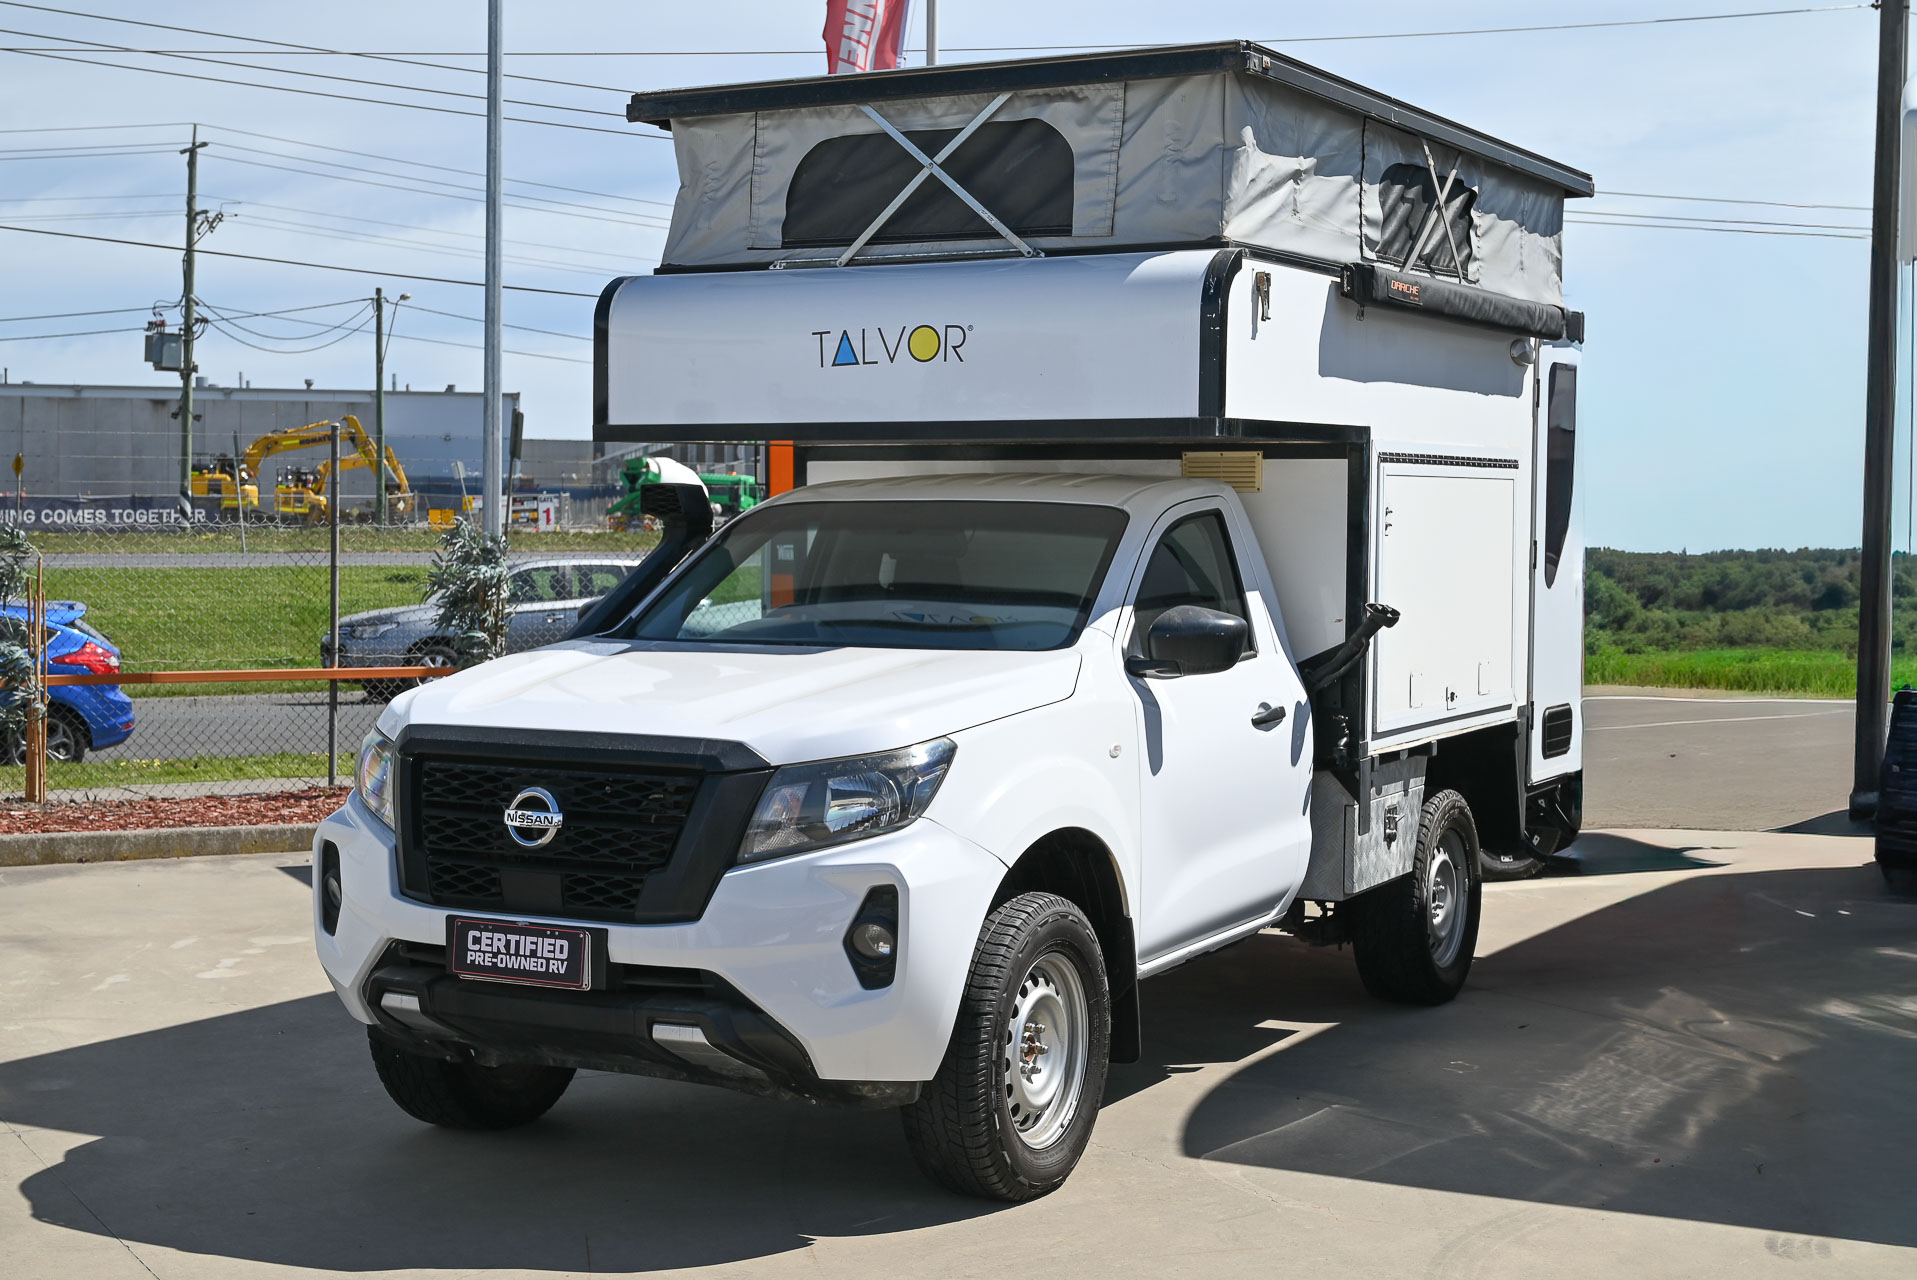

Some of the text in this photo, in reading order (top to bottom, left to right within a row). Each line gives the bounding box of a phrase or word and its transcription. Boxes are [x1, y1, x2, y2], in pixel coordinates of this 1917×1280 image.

[1391, 279, 1420, 296] DARCHE
[811, 324, 967, 368] TALVOR
[40, 508, 107, 524] COMES
[111, 508, 206, 524] TOGETHR
[542, 507, 551, 525] 1
[506, 810, 554, 827] NISSAN
[467, 929, 569, 960] CERTIFIED
[466, 951, 568, 974] PRE-OWNED RV
